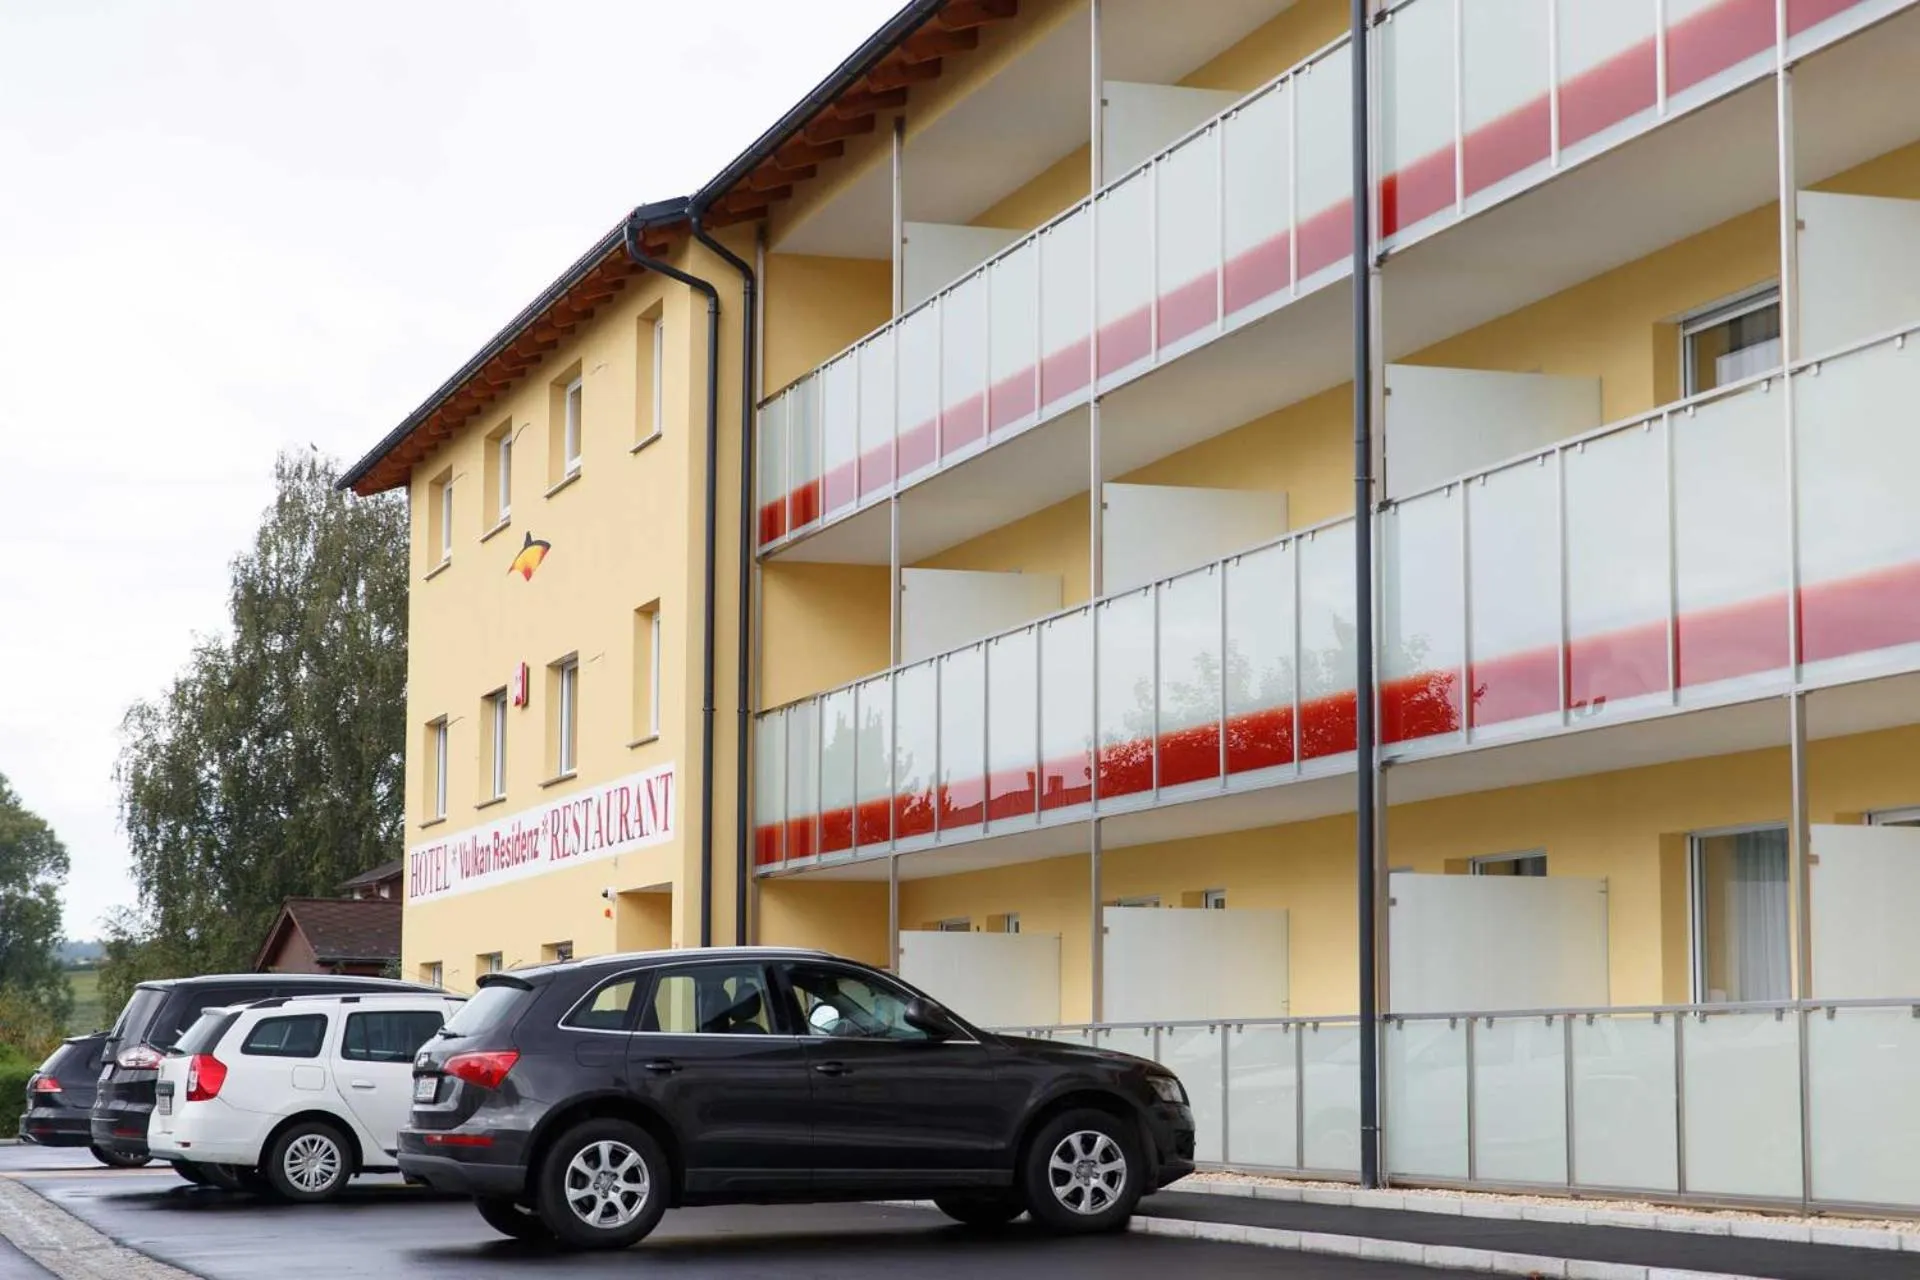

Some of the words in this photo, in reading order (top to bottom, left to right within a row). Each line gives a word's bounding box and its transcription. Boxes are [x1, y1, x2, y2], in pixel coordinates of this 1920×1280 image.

[410, 844, 450, 898] HOTEL
[459, 835, 491, 880] Vulkan
[493, 821, 540, 871] Residenz
[550, 772, 674, 861] RESTAURANT
